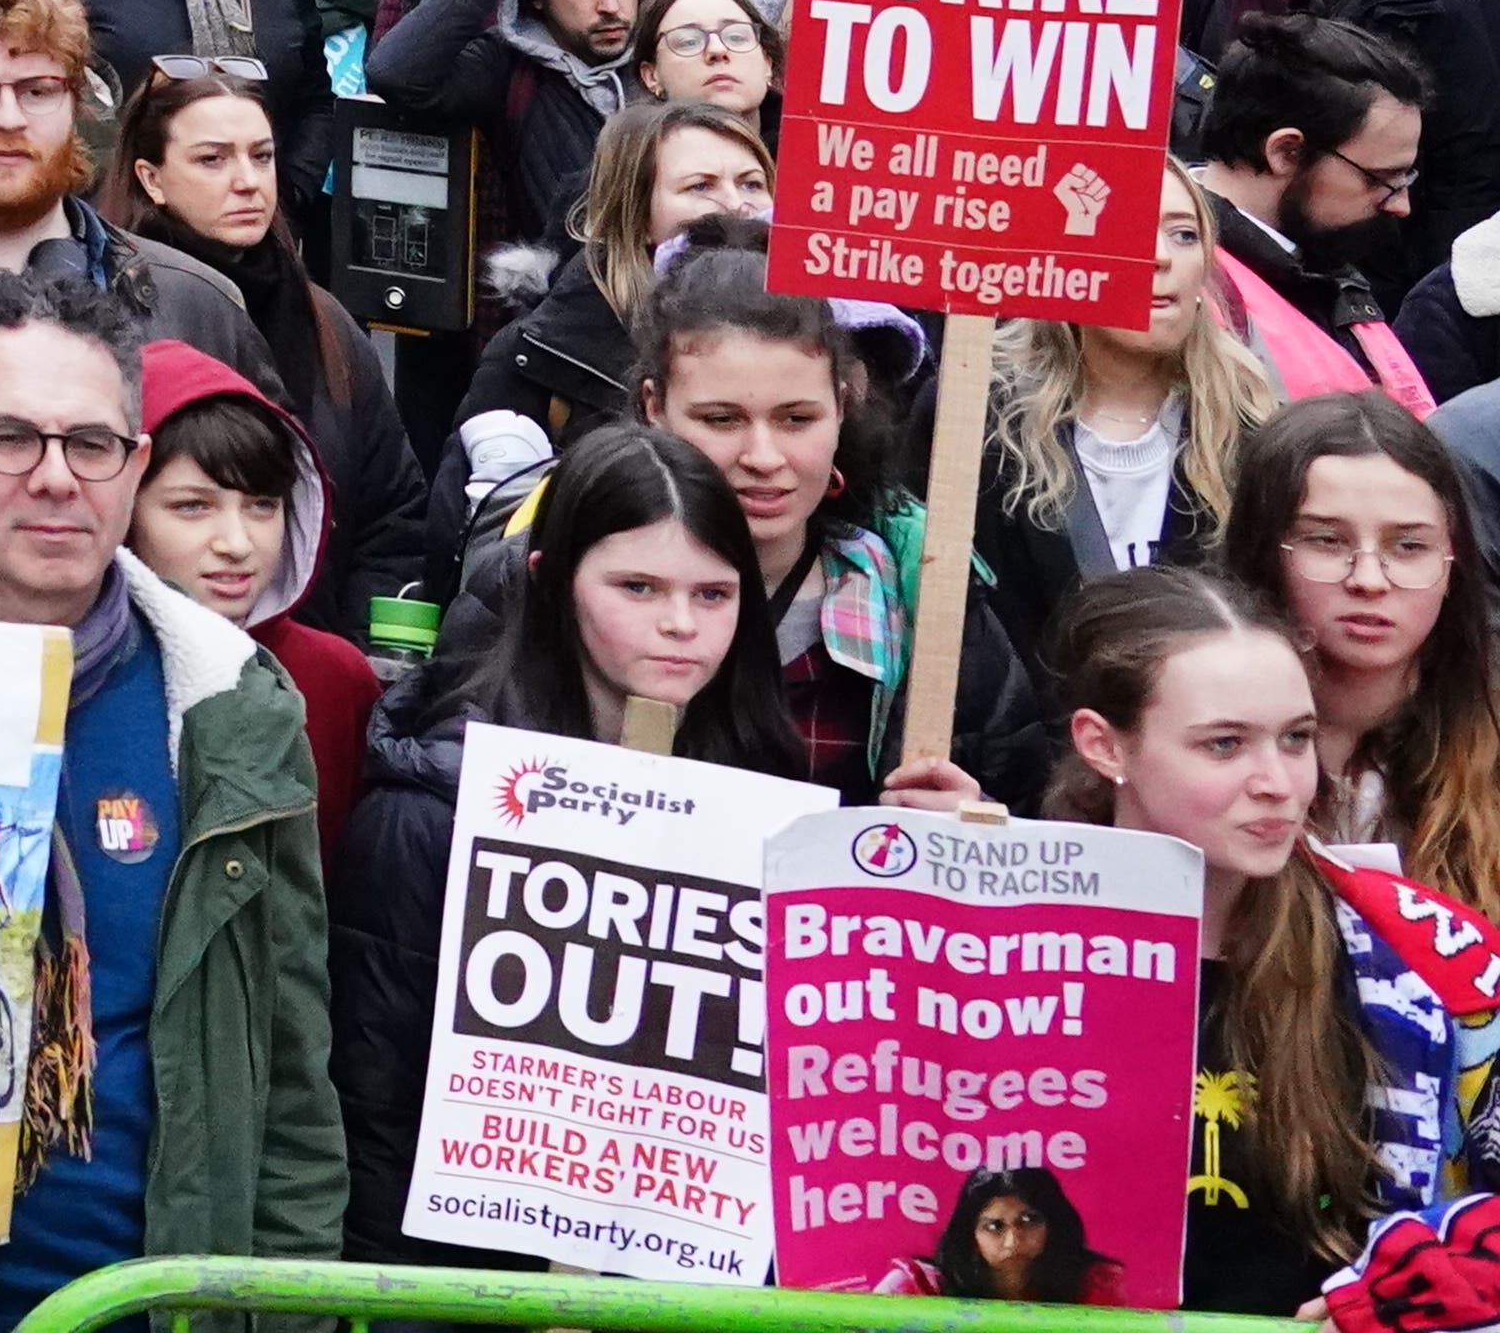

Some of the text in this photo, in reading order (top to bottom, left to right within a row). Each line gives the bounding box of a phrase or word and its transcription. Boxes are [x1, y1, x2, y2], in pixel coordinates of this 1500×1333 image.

[810, 0, 1156, 131] TO WIN
[817, 124, 1047, 187] We all need
[811, 182, 1011, 232] a pay rise
[804, 232, 1108, 305] Strike together
[98, 799, 138, 818] PAY
[526, 789, 637, 826] Party
[541, 766, 697, 817] Socialist
[927, 833, 1083, 866] STAND UP
[927, 861, 1099, 896] TO RACISM
[476, 849, 765, 970] TORIES
[784, 903, 1176, 983] Braverman
[466, 930, 764, 1077] OUT!
[784, 969, 1085, 1039] out now!
[449, 1074, 765, 1154] DOESN'T FIGHT FOR US
[472, 1051, 747, 1122] STARMER'S LABOUR
[787, 1039, 1108, 1120] Refugees
[482, 1115, 717, 1184] BUILD A NEW
[787, 1105, 1087, 1172] welcome
[442, 1138, 756, 1226] WORKERS' PARTY
[789, 1175, 938, 1232] here
[428, 1191, 743, 1277] socialistparty.org.uk
